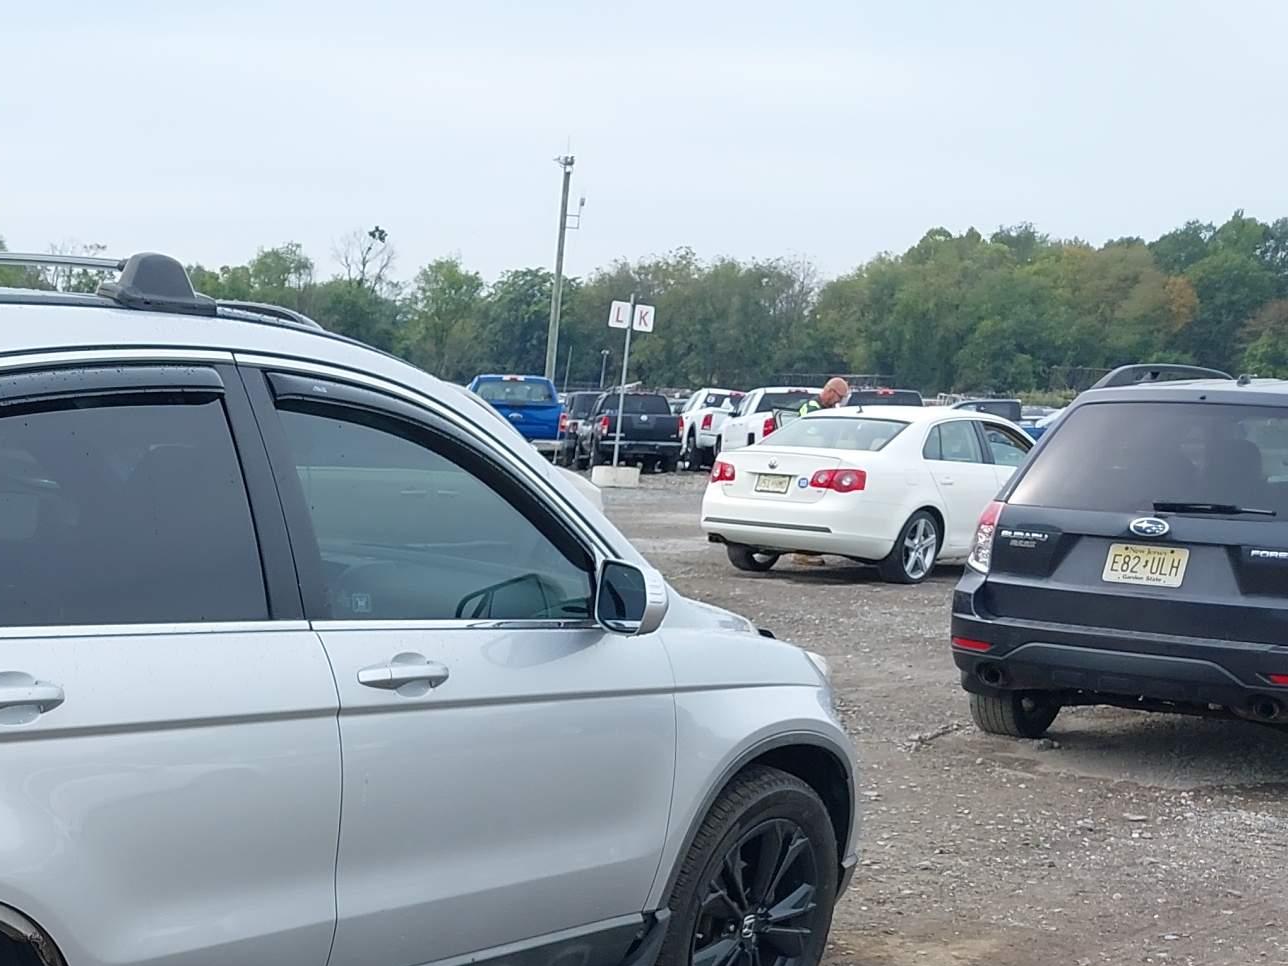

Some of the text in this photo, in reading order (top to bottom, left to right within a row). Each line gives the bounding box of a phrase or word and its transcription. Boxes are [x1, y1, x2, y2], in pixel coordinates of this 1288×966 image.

[616, 306, 623, 323] L
[639, 309, 649, 327] K
[1001, 530, 1049, 541] SUBARU
